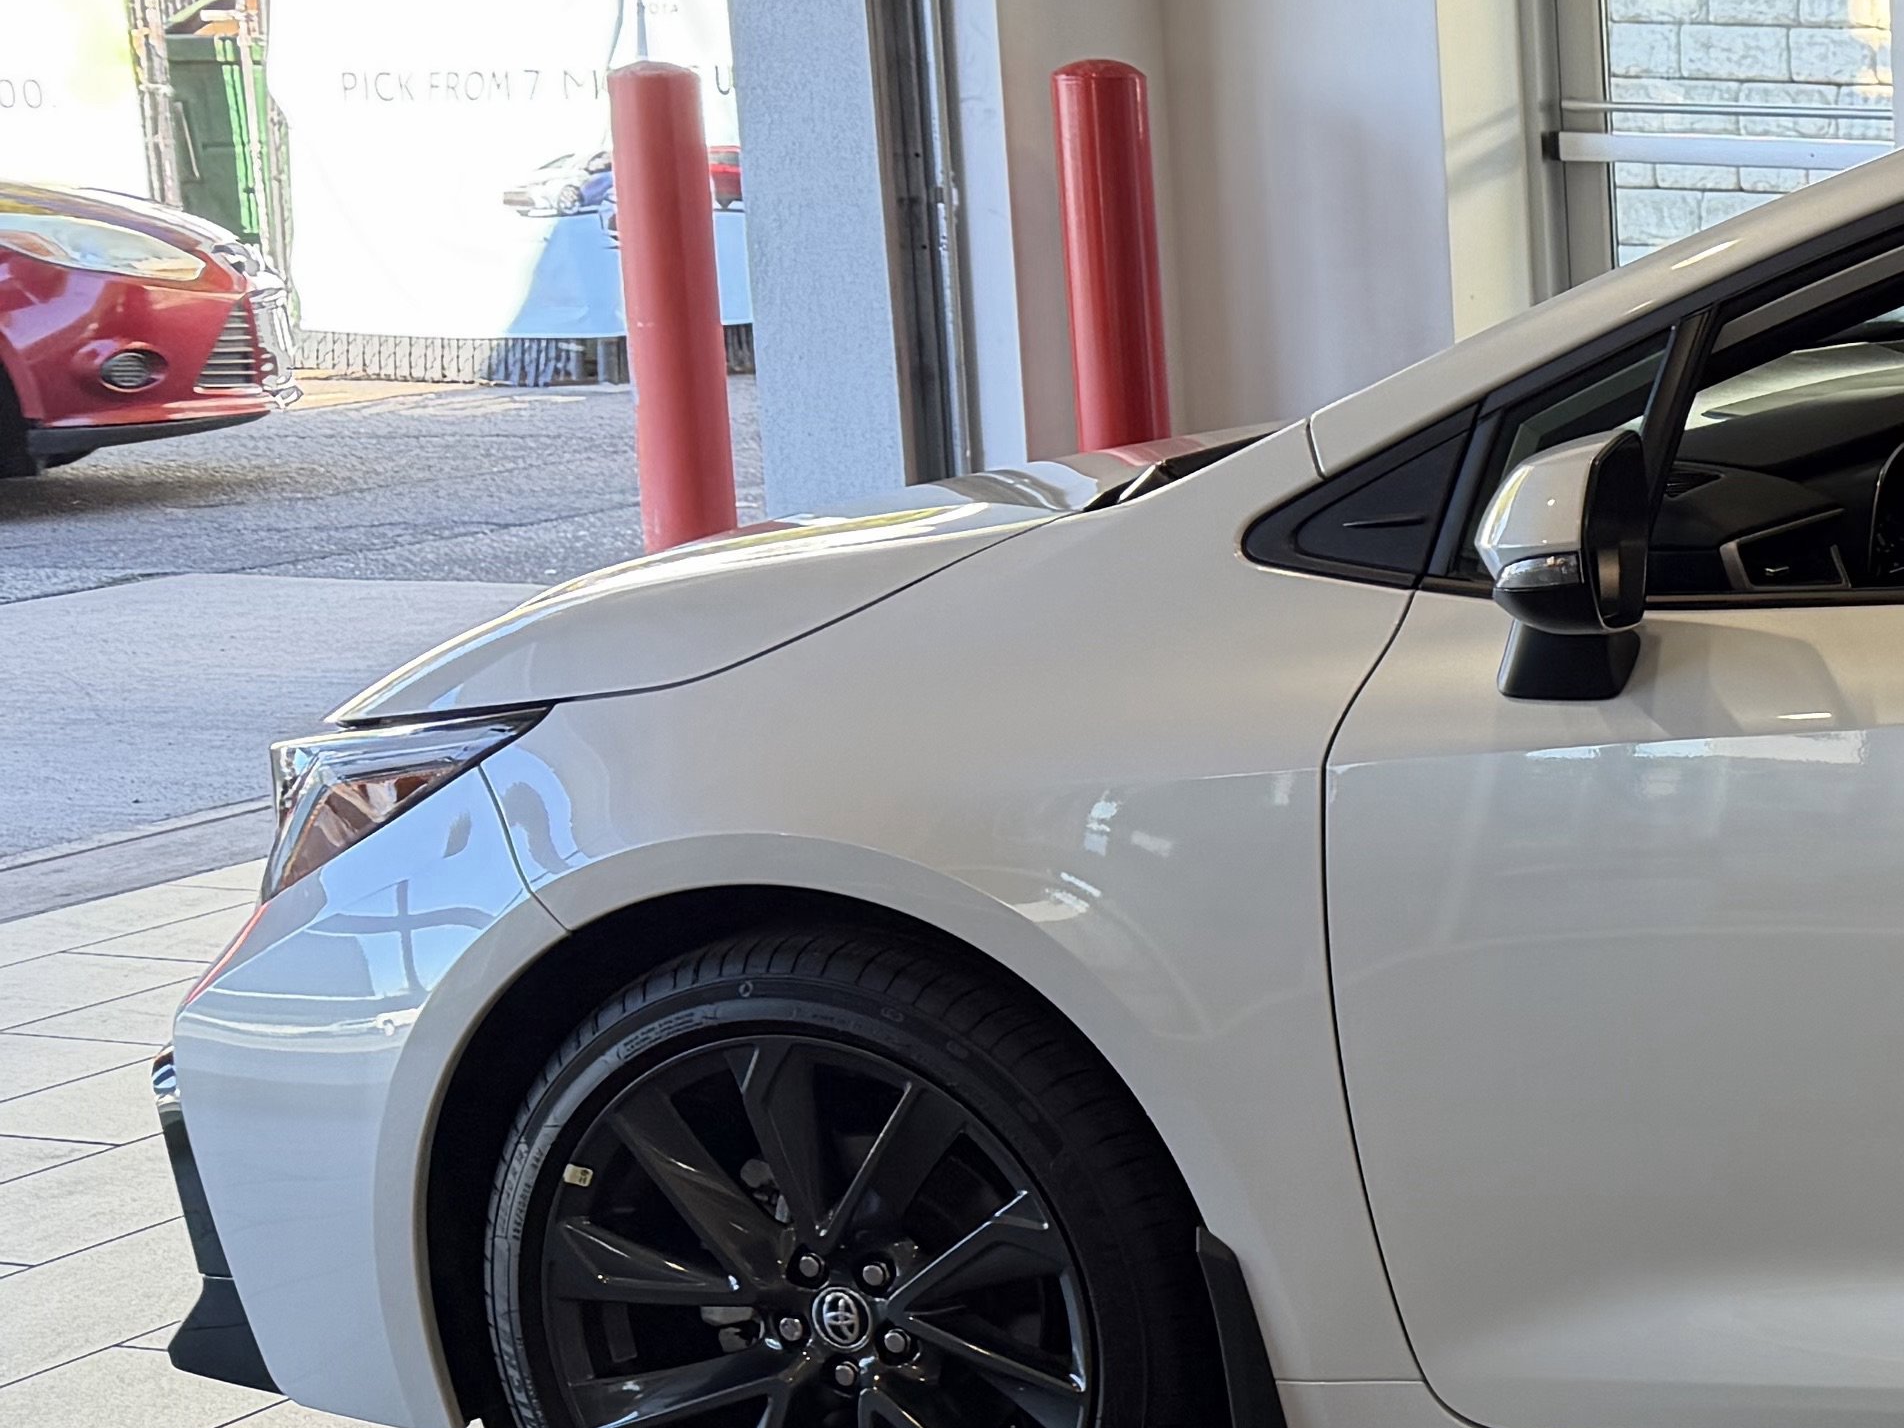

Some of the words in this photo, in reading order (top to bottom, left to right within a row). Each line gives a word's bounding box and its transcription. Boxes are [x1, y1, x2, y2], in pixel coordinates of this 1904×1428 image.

[342, 72, 414, 101] PICK
[430, 71, 510, 101] FROM
[524, 70, 539, 101] 7
